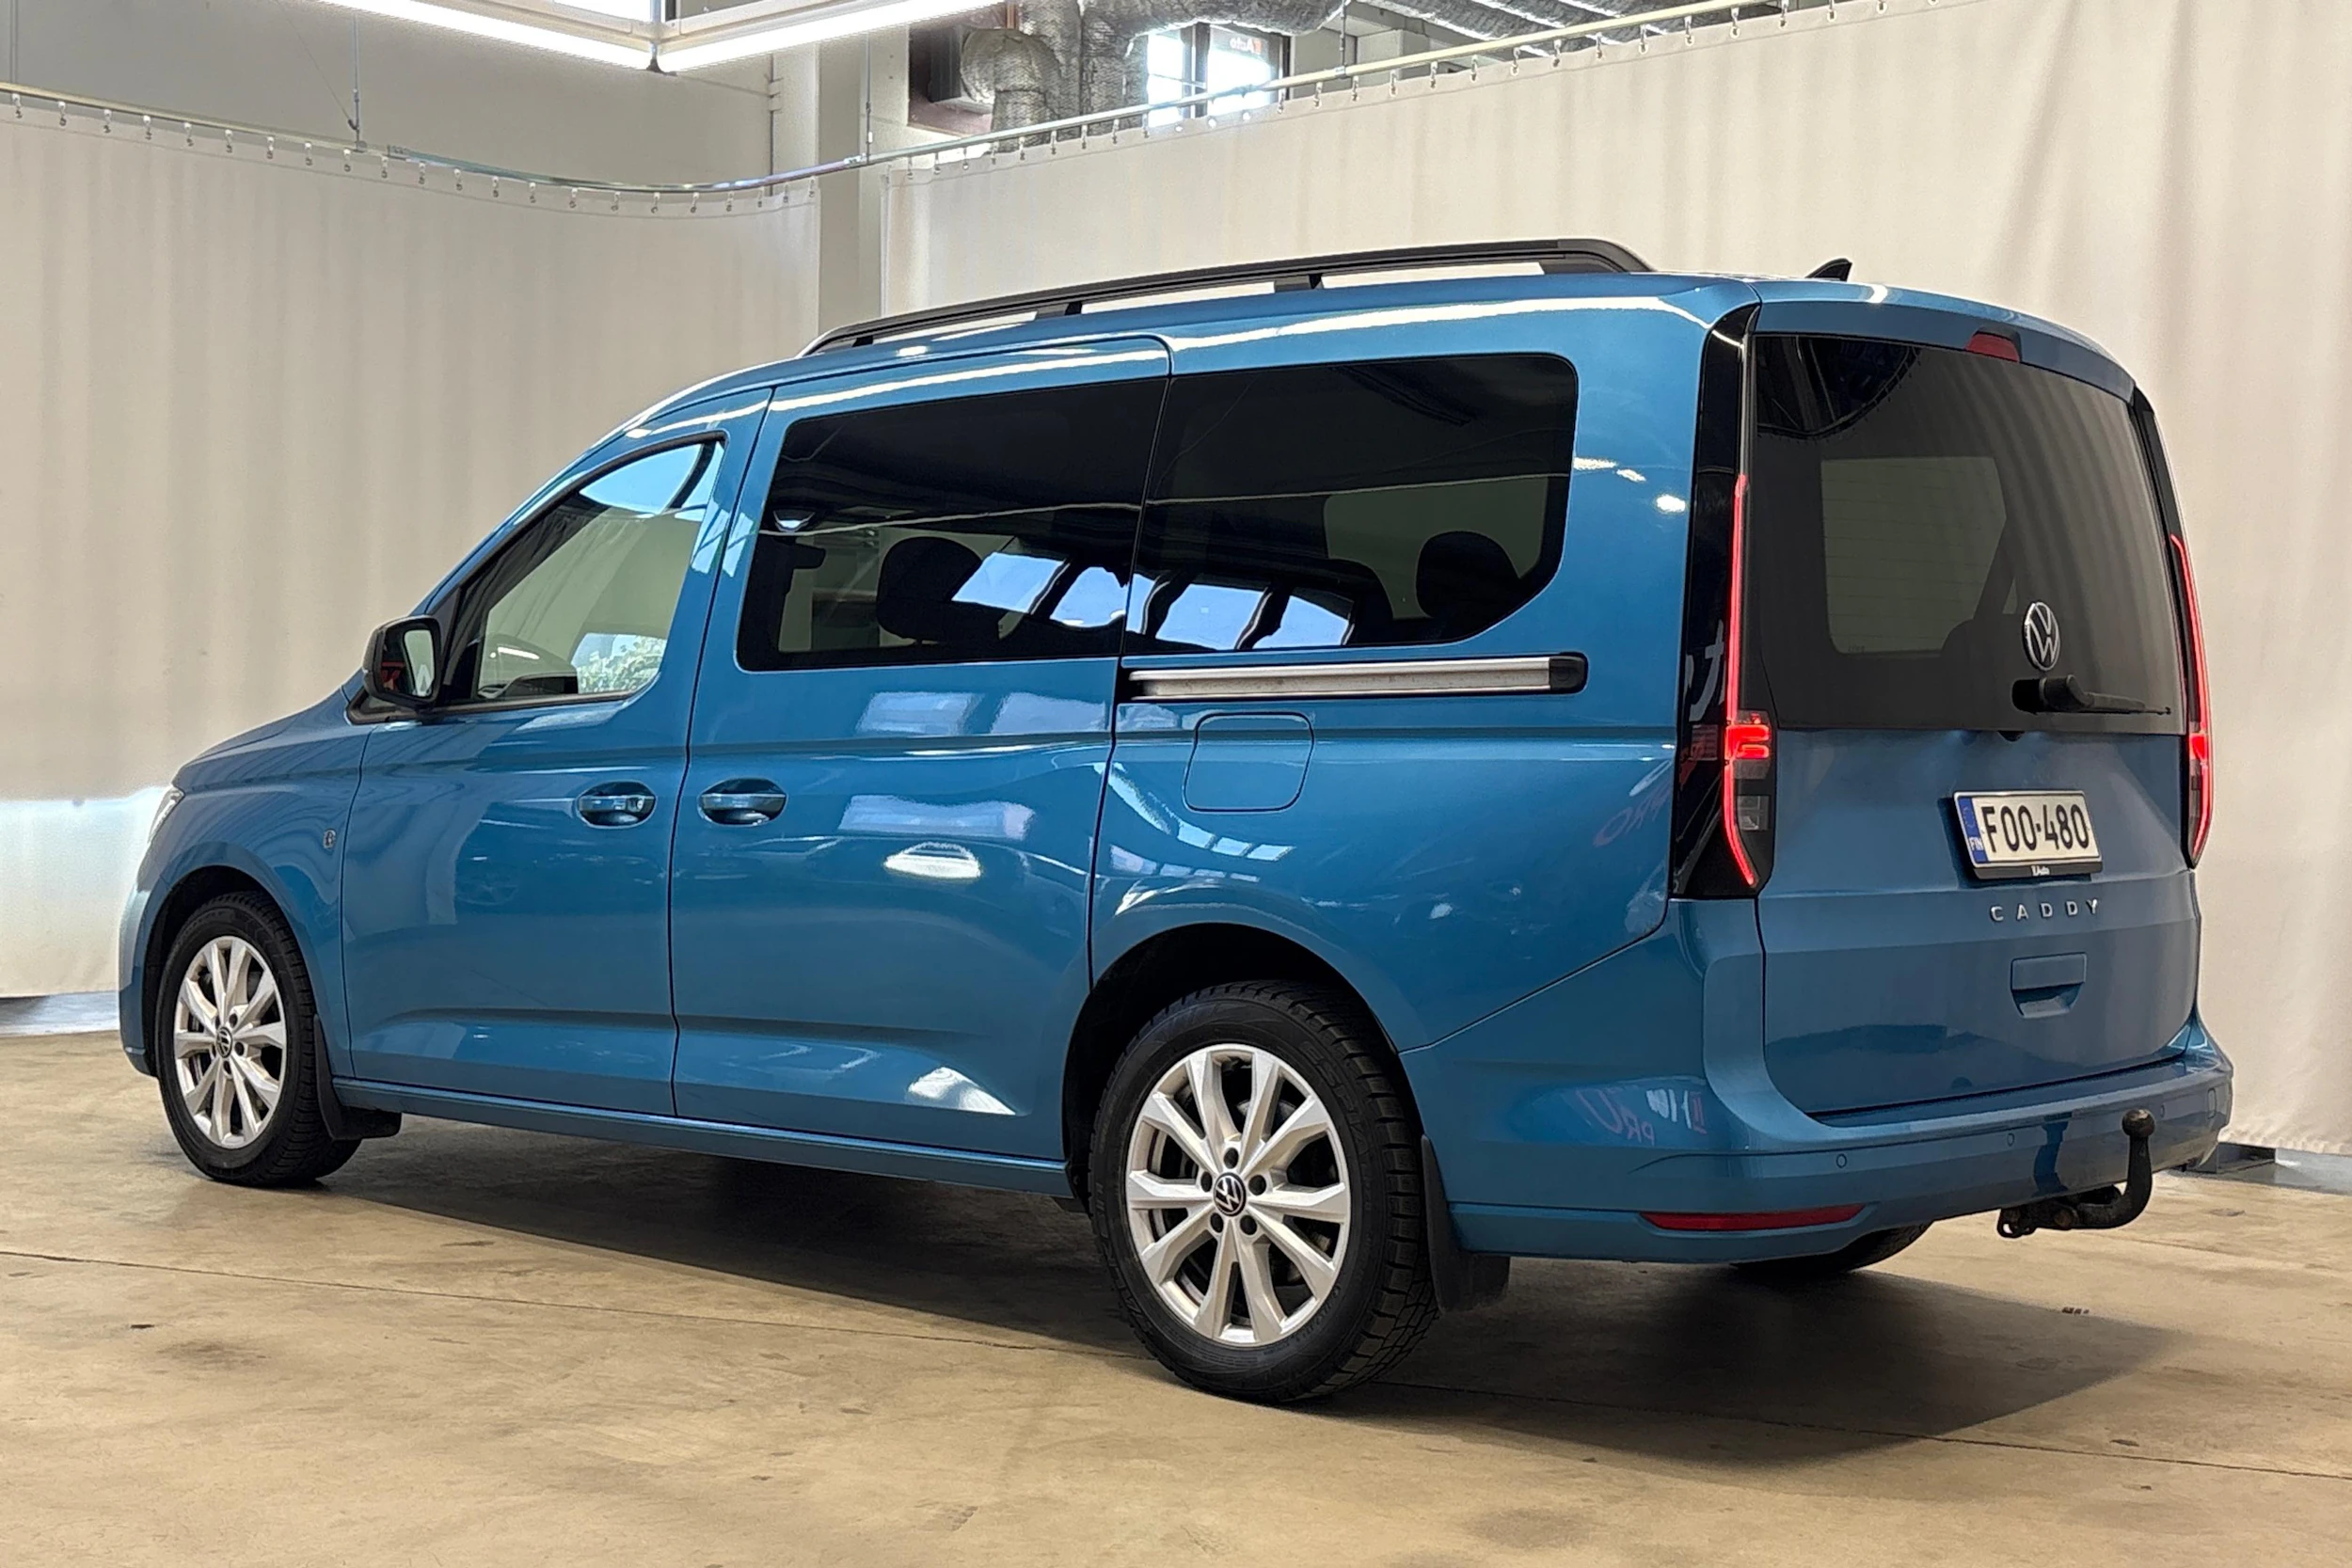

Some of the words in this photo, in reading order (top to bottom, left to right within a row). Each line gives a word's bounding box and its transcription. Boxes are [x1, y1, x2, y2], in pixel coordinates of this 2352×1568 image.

[1981, 804, 2090, 853] FOO-480
[1968, 836, 1984, 851] FIN
[1991, 898, 2099, 922] CADDY
